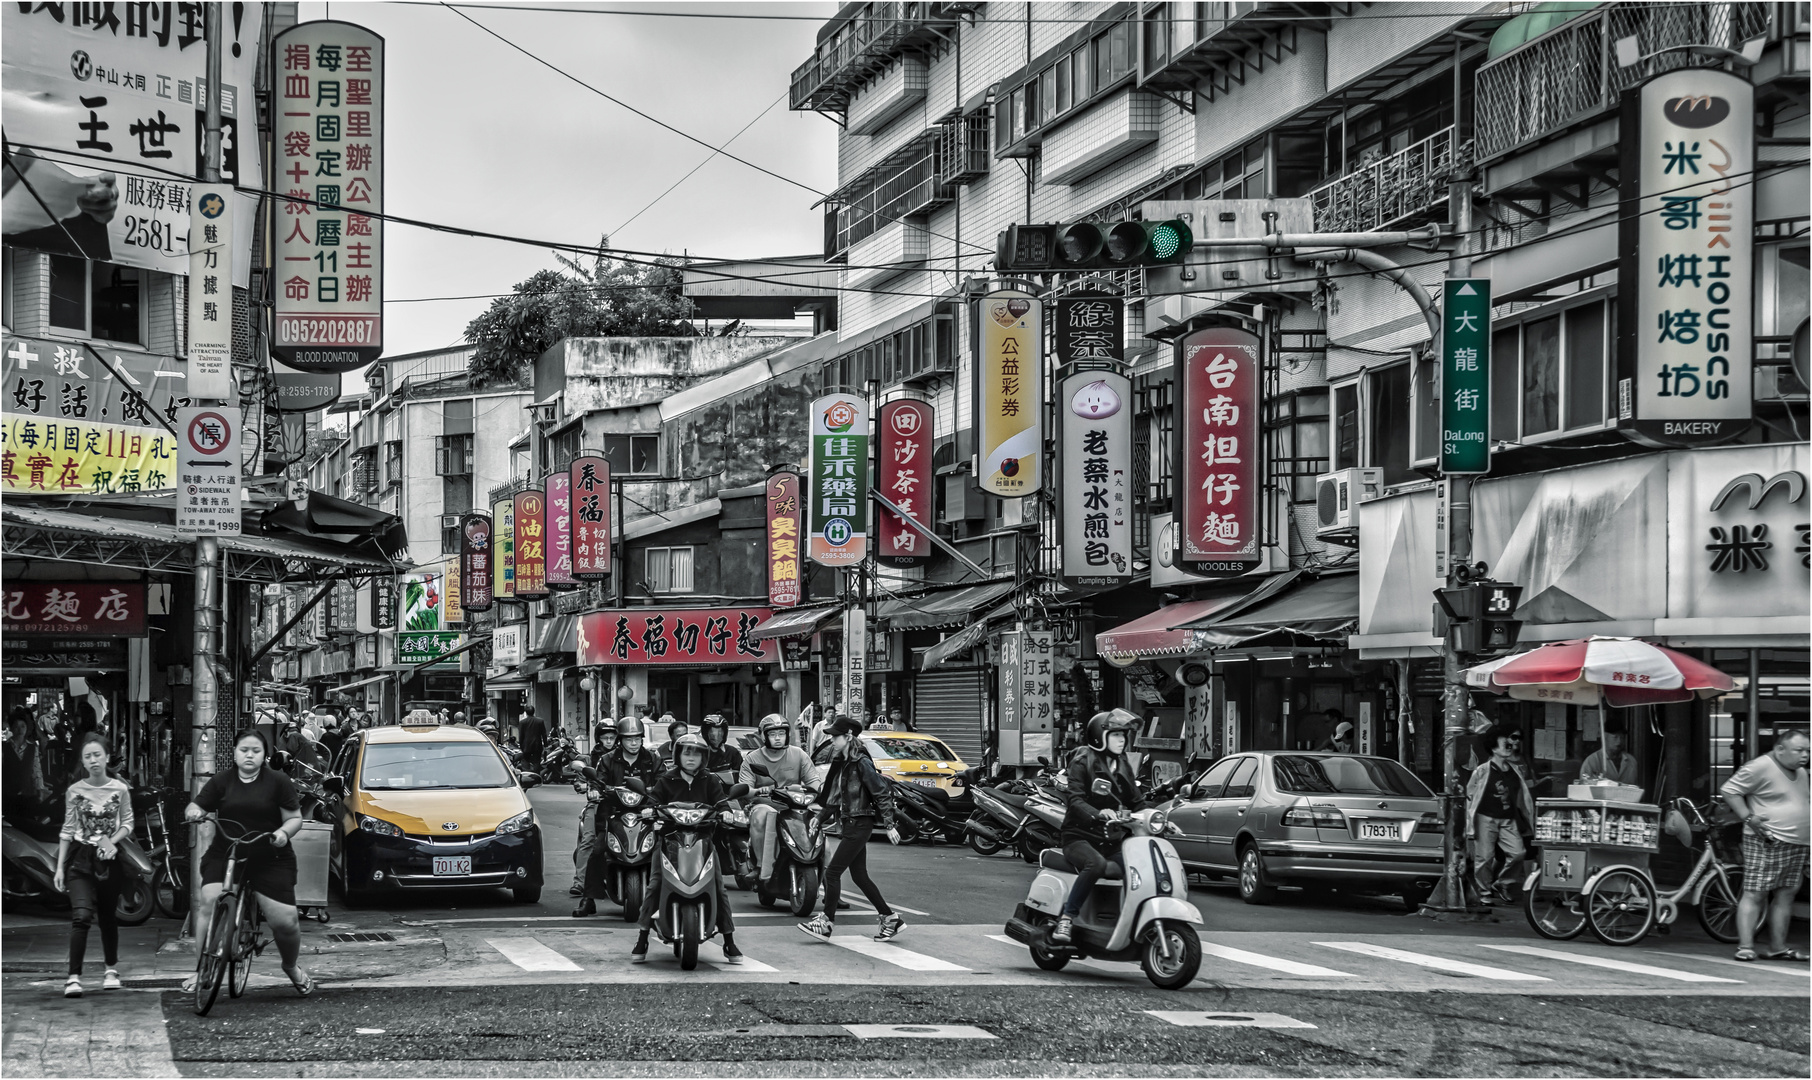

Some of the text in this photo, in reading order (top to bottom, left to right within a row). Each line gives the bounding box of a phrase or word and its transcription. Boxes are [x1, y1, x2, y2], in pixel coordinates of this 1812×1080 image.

[96, 66, 146, 91] 中山 大同
[346, 47, 372, 301] 至聖里辦公處主辦
[125, 176, 190, 213] 服務專
[125, 215, 190, 252] 2581-
[203, 224, 218, 321] 魅力據點
[1657, 140, 1703, 398] 米哥烘焙坊
[281, 319, 374, 344] 0952202887
[296, 351, 359, 363] BLOOD DONATION
[1454, 310, 1480, 411] 大龍街
[1001, 337, 1020, 417] 公益彩券
[199, 423, 221, 445] 停
[1444, 429, 1485, 443] DaLong
[1664, 422, 1722, 435] BAKERY
[1444, 443, 1460, 455] St.
[91, 465, 167, 494] 祝福你
[576, 463, 605, 524] 春福
[821, 437, 857, 517] 佳禾藥局
[892, 439, 920, 552] 沙茶羊肉
[190, 496, 230, 506] 違者拖吊
[1083, 430, 1110, 566] 老蔡水煎包
[217, 522, 240, 531] 1999
[519, 519, 544, 560] 油飯
[577, 527, 591, 569] 魯肉飯
[593, 527, 607, 570] 切仔麵
[1197, 562, 1244, 571] NOODLES
[1078, 576, 1119, 585] Dumpling Bun
[1023, 638, 1036, 719] 現打果汁
[1038, 638, 1051, 719] 各式冰沙
[1361, 824, 1399, 838] 1783-TH
[434, 860, 470, 873] 701-K2
